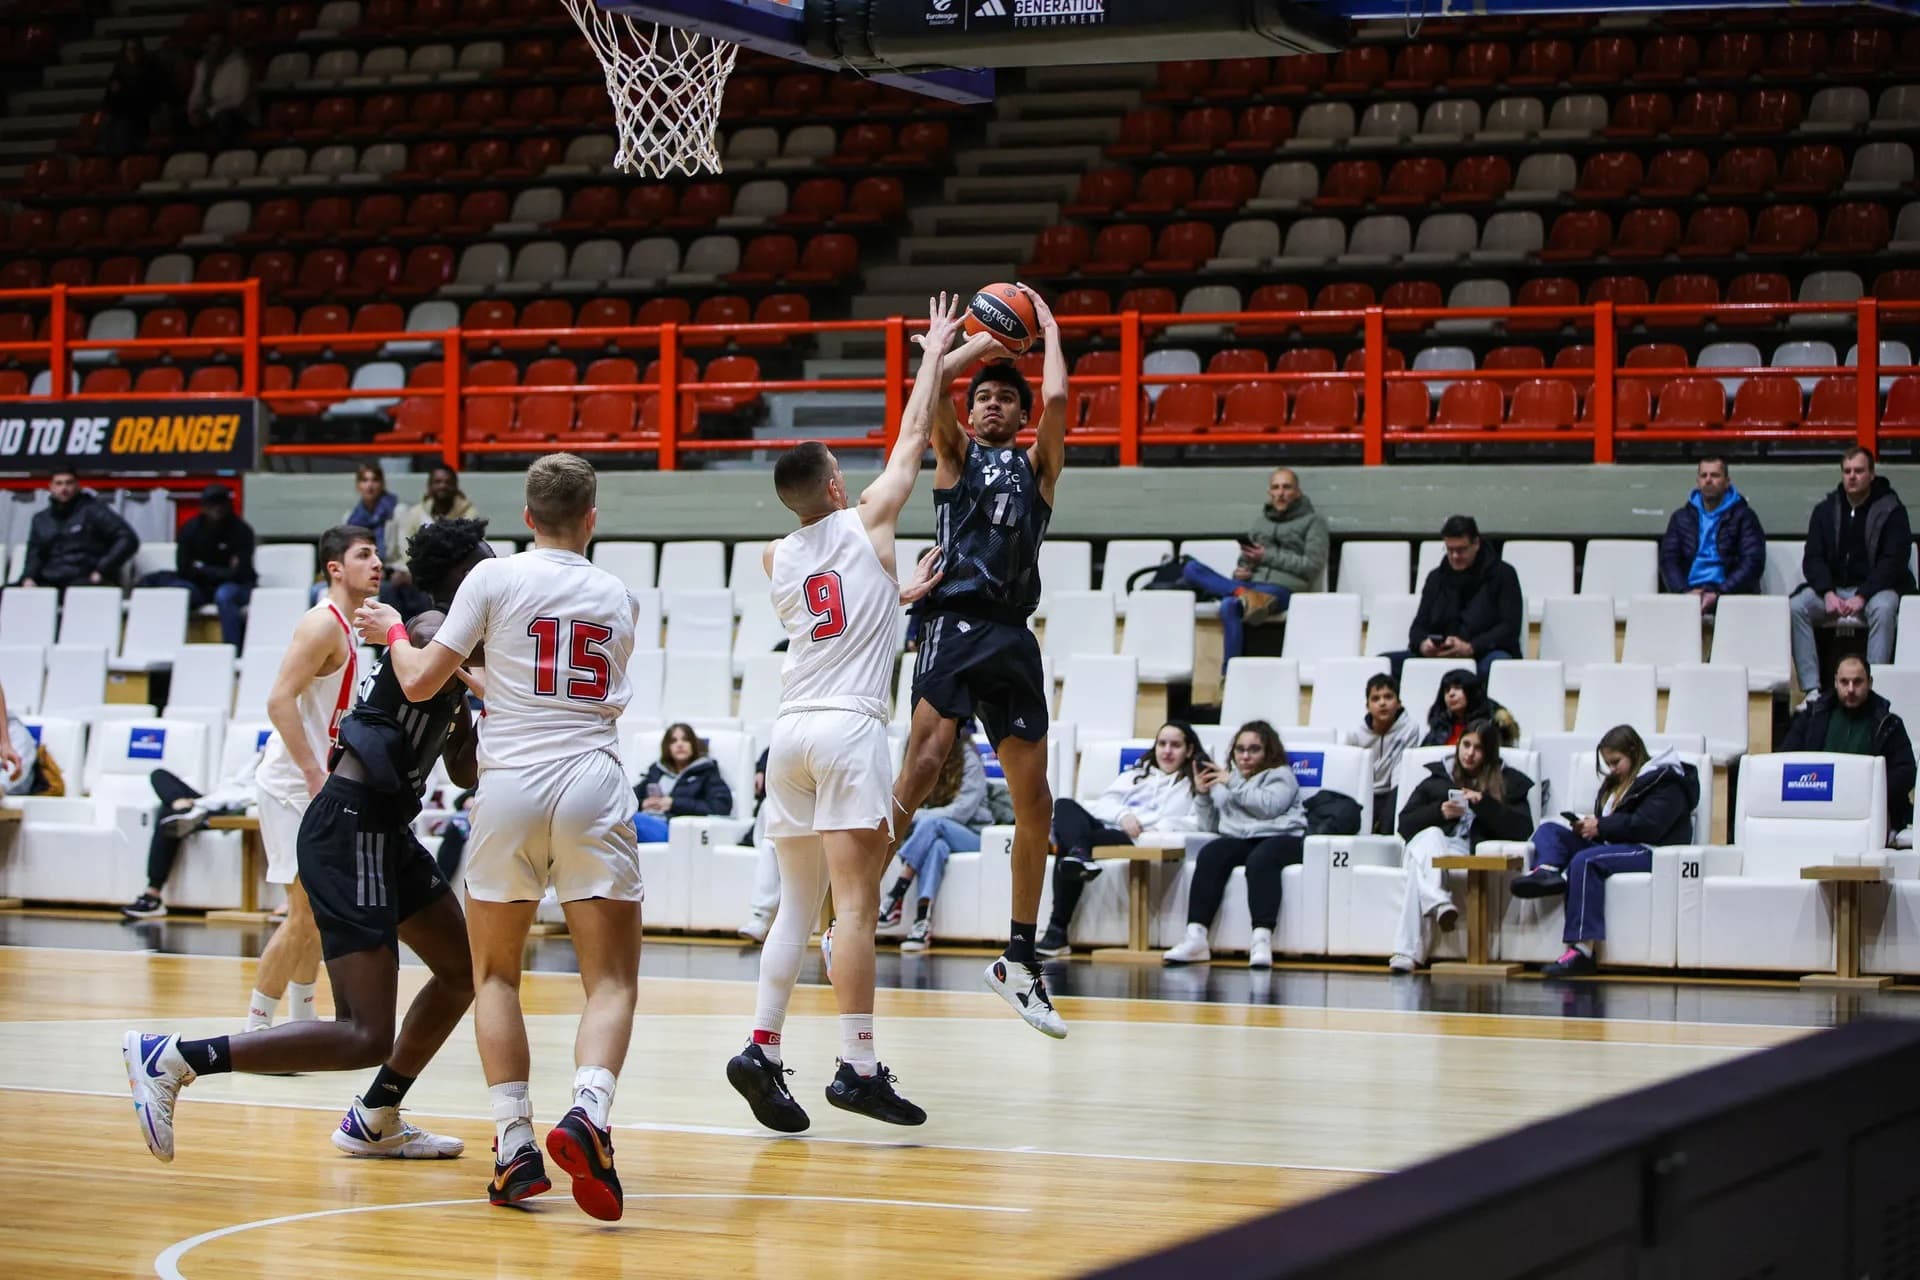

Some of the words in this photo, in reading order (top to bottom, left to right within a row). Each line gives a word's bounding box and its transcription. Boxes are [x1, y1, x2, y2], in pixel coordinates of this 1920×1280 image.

[1014, 14, 1104, 27] TOURNAMENT
[973, 295, 1017, 332] SPALDING
[27, 418, 65, 455] TO
[66, 417, 110, 455] BE
[110, 414, 240, 454] ORANGE!
[803, 570, 847, 642] 9
[527, 617, 613, 702] 15
[1332, 851, 1349, 867] 22
[1681, 861, 1699, 878] 20
